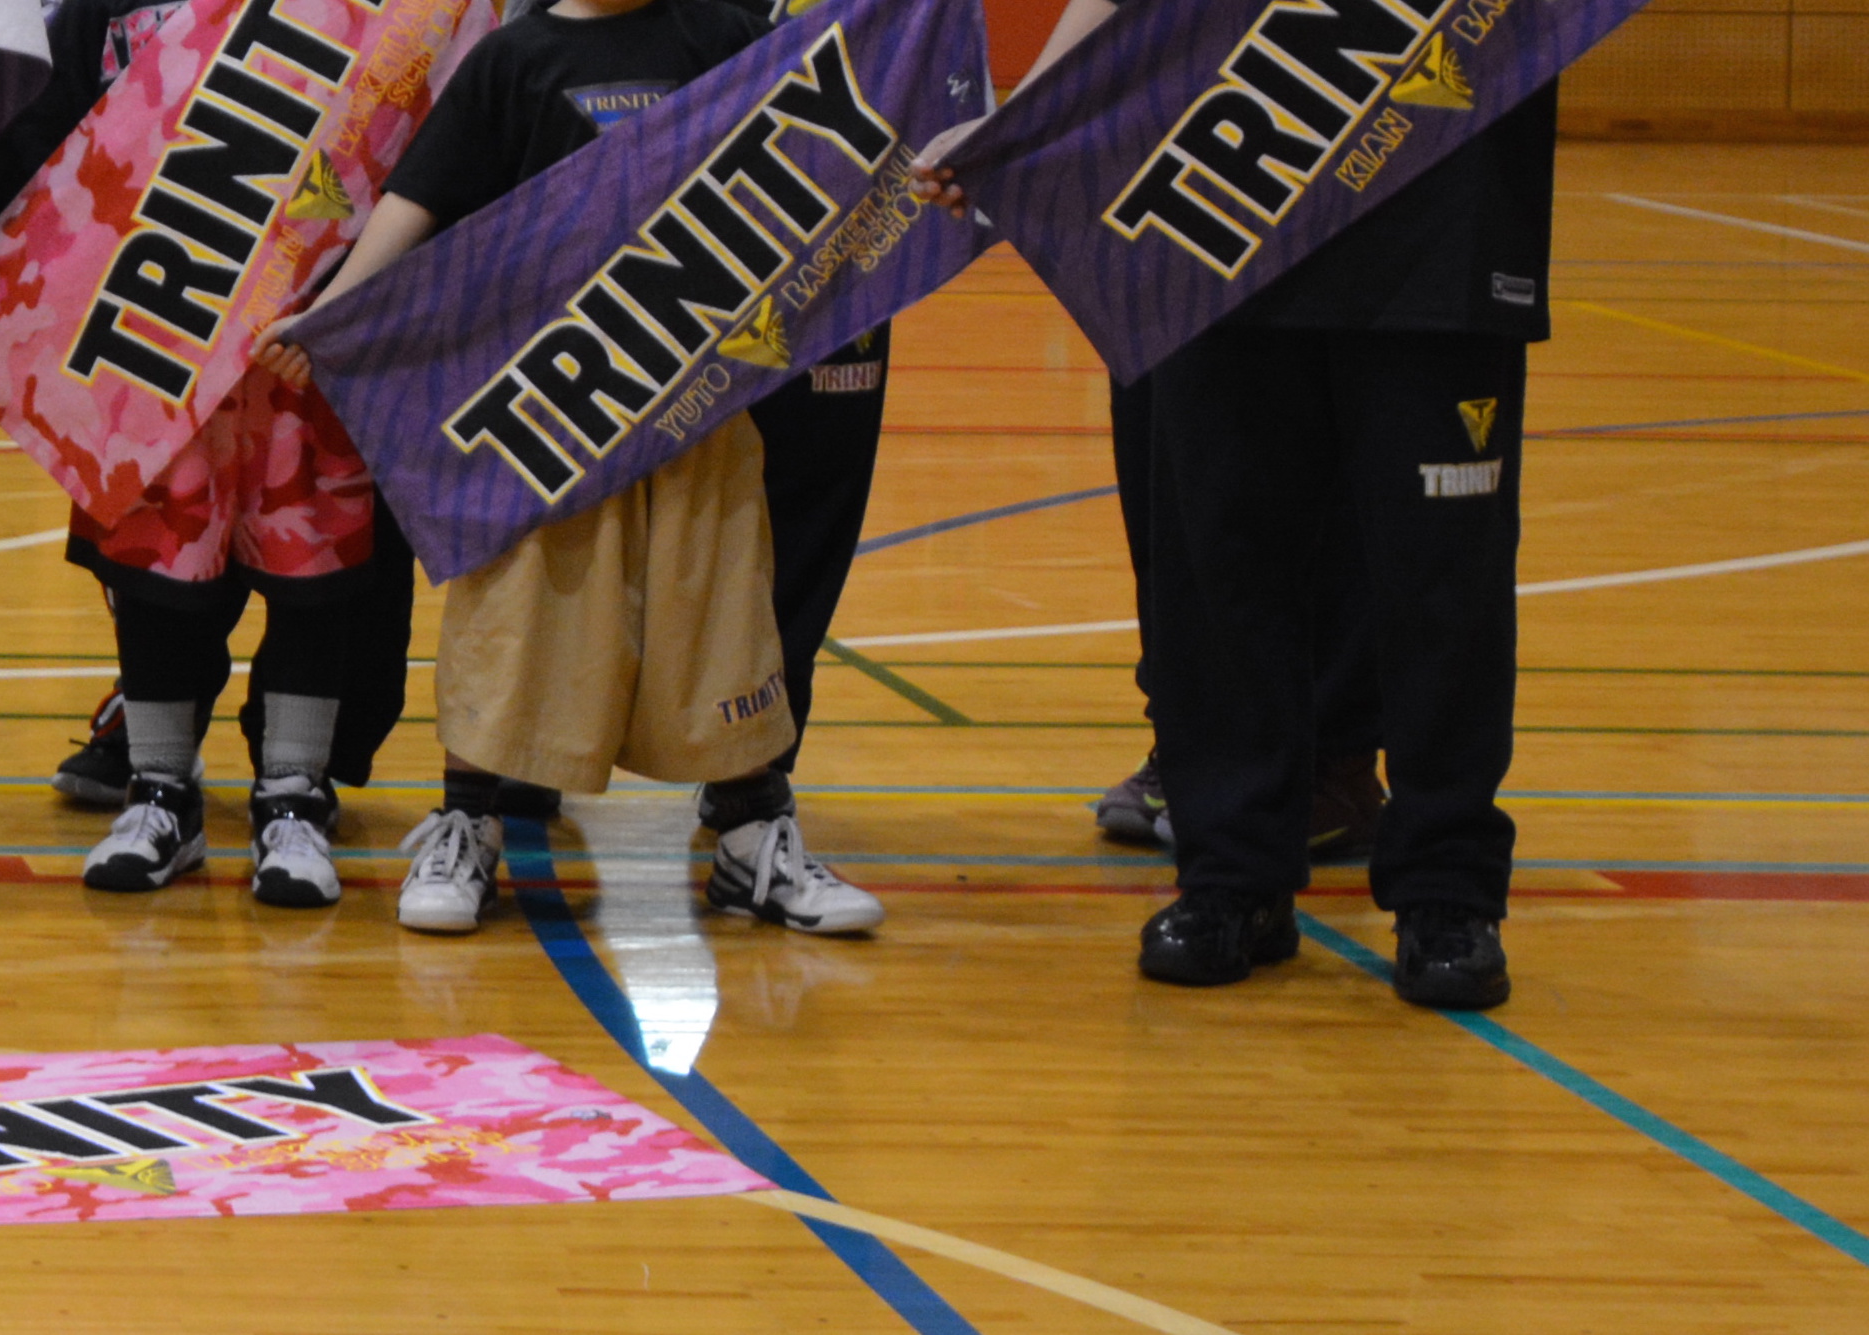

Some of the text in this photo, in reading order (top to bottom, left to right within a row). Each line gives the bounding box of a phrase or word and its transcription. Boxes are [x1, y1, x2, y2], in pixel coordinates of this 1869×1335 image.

[1334, 106, 1414, 193] KIAN
[442, 20, 899, 505] TRINITY
[653, 363, 733, 443] YUTO
